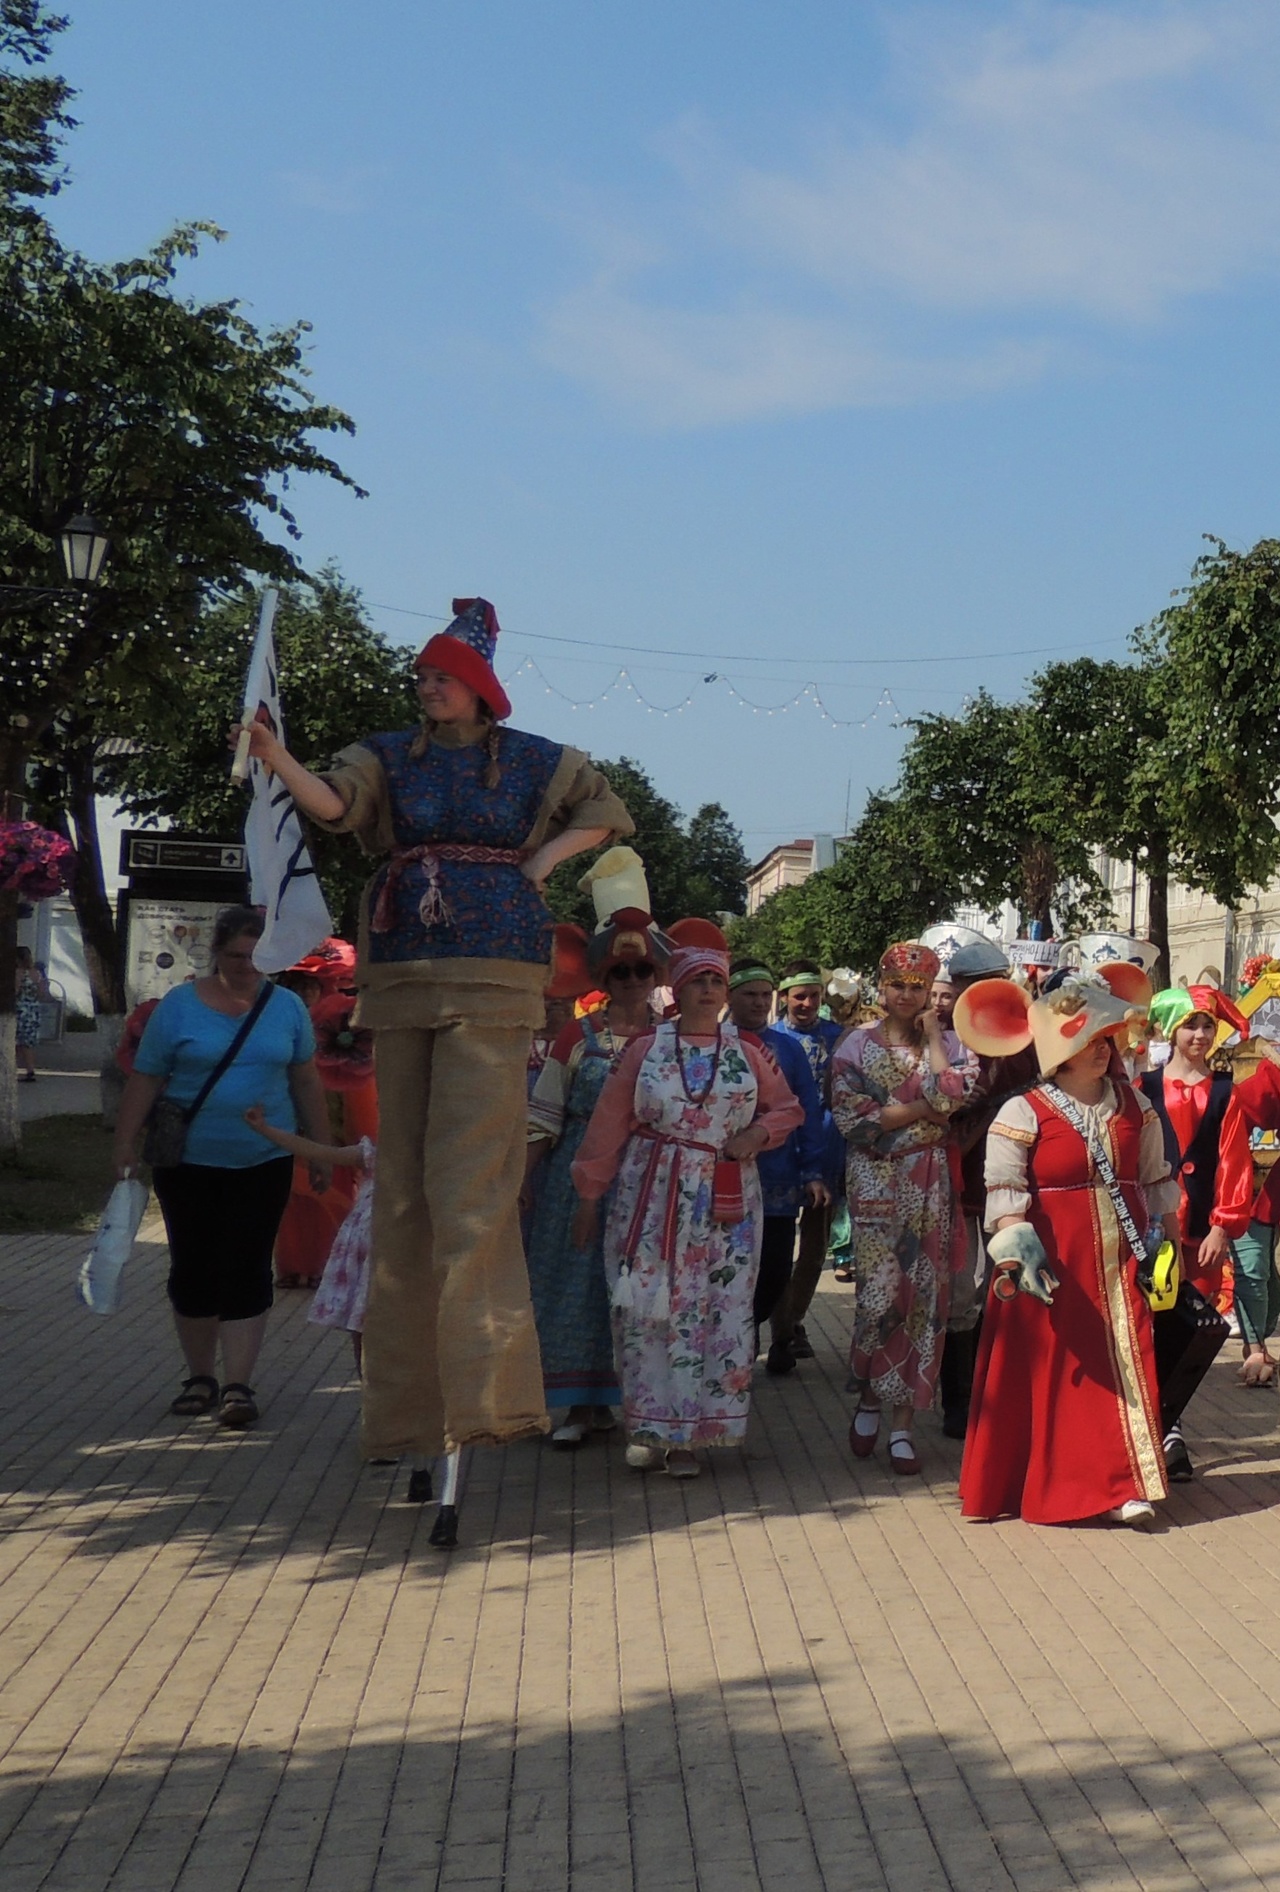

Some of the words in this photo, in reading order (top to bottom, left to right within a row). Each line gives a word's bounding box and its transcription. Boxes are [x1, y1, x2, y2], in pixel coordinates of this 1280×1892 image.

[1050, 1088, 1070, 1109] NICE
[1062, 1105, 1083, 1125] NICE
[1098, 1160, 1116, 1185] NICE
[1112, 1195, 1130, 1220] NICE
[1121, 1218, 1140, 1242] NICE
